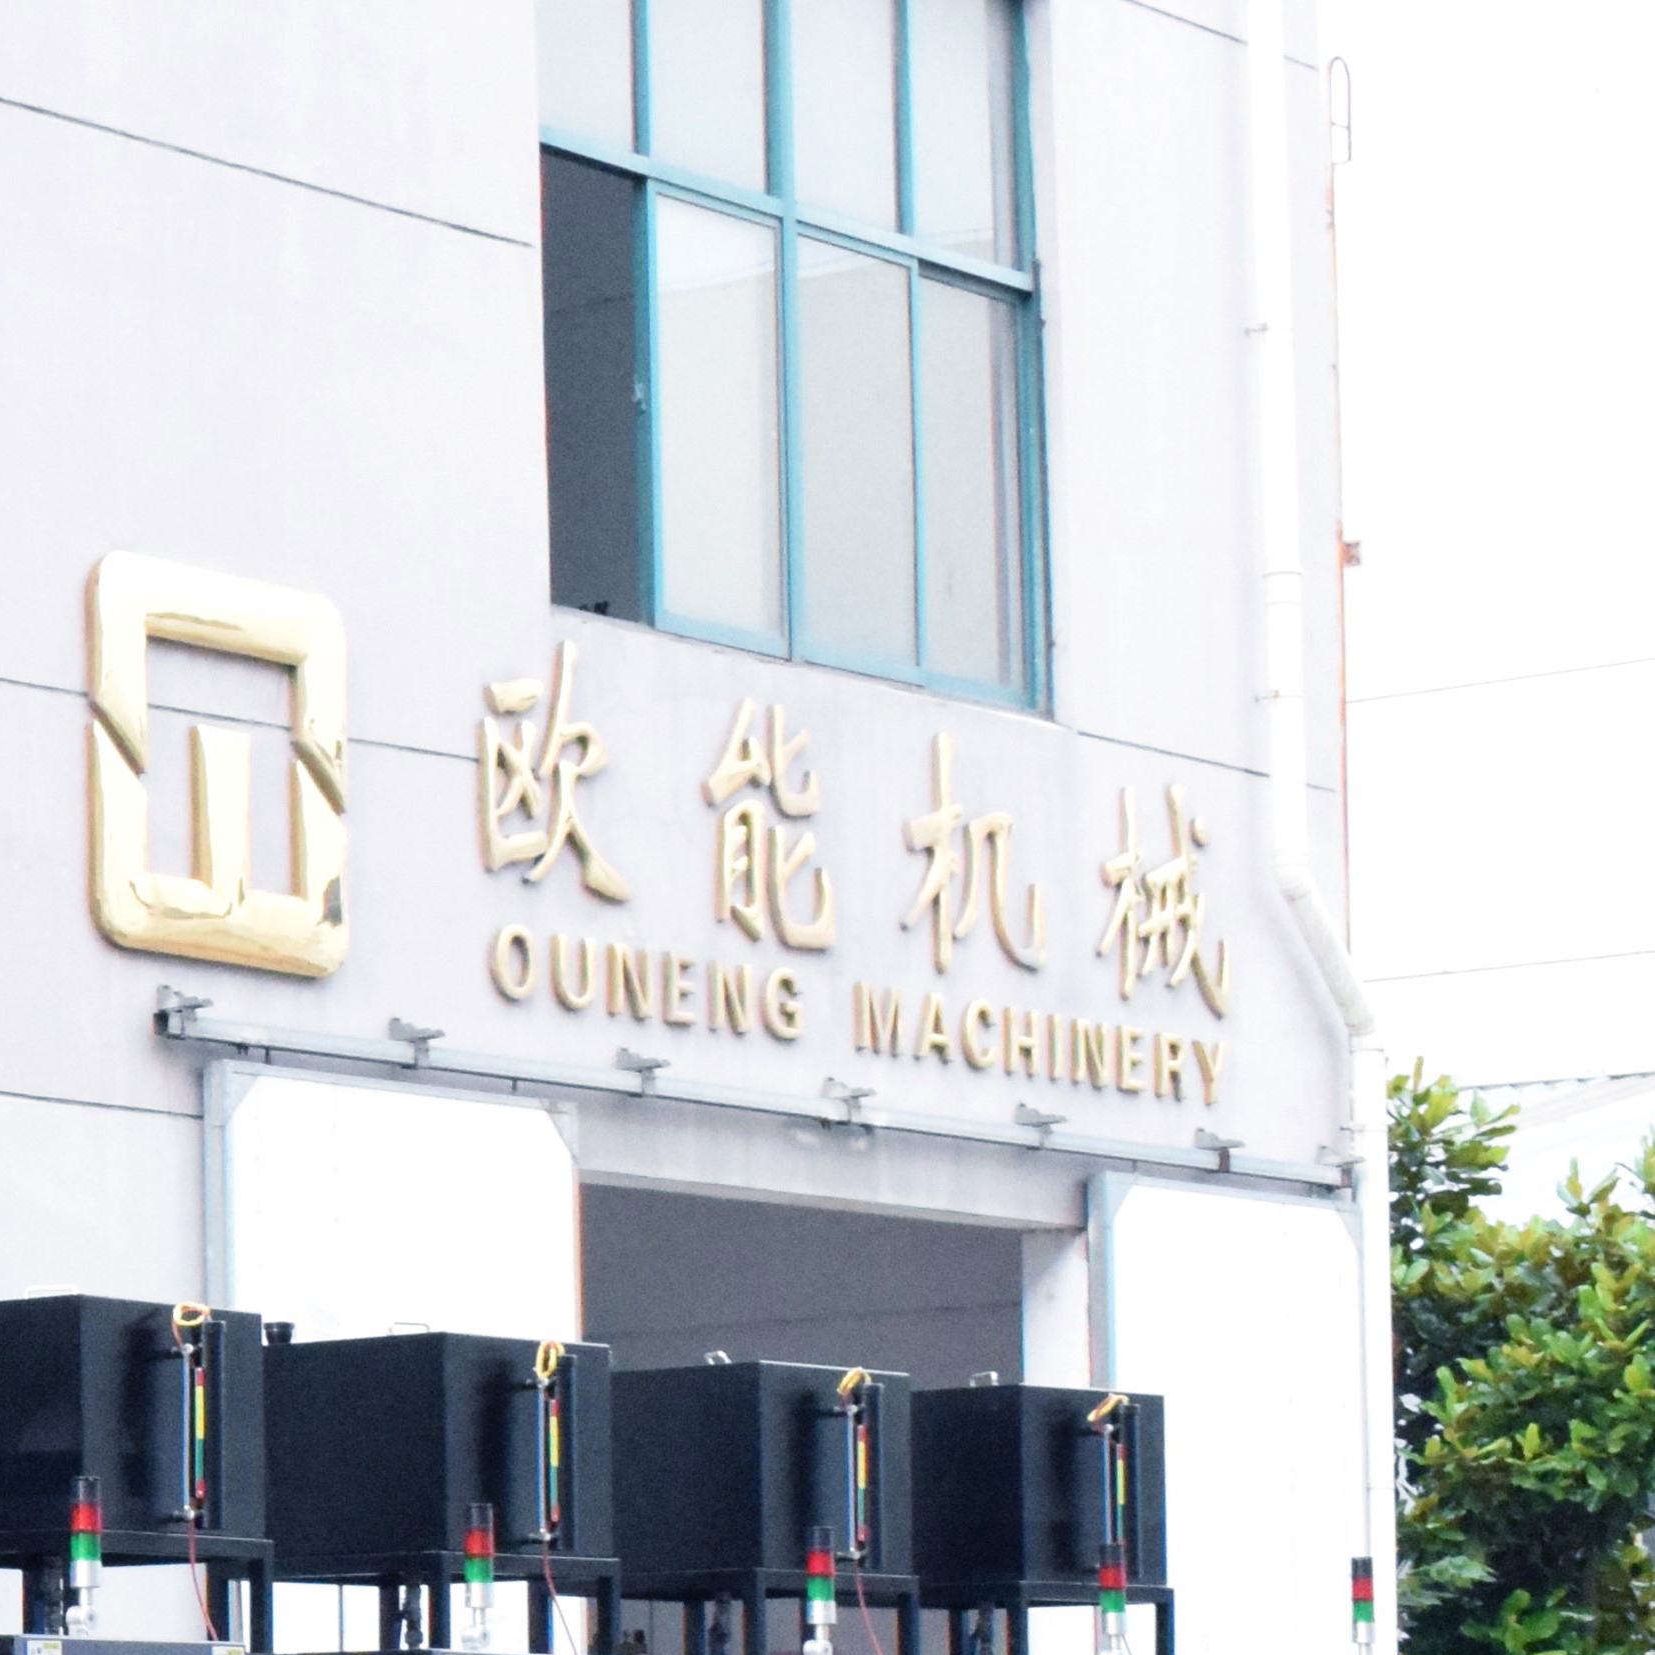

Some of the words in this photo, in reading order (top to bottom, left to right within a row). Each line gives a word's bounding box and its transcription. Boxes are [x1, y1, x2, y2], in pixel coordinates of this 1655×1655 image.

[477, 639, 1233, 1020] 欧能机械
[490, 924, 806, 1041] OUNENG
[852, 980, 1227, 1107] MACHINERY
